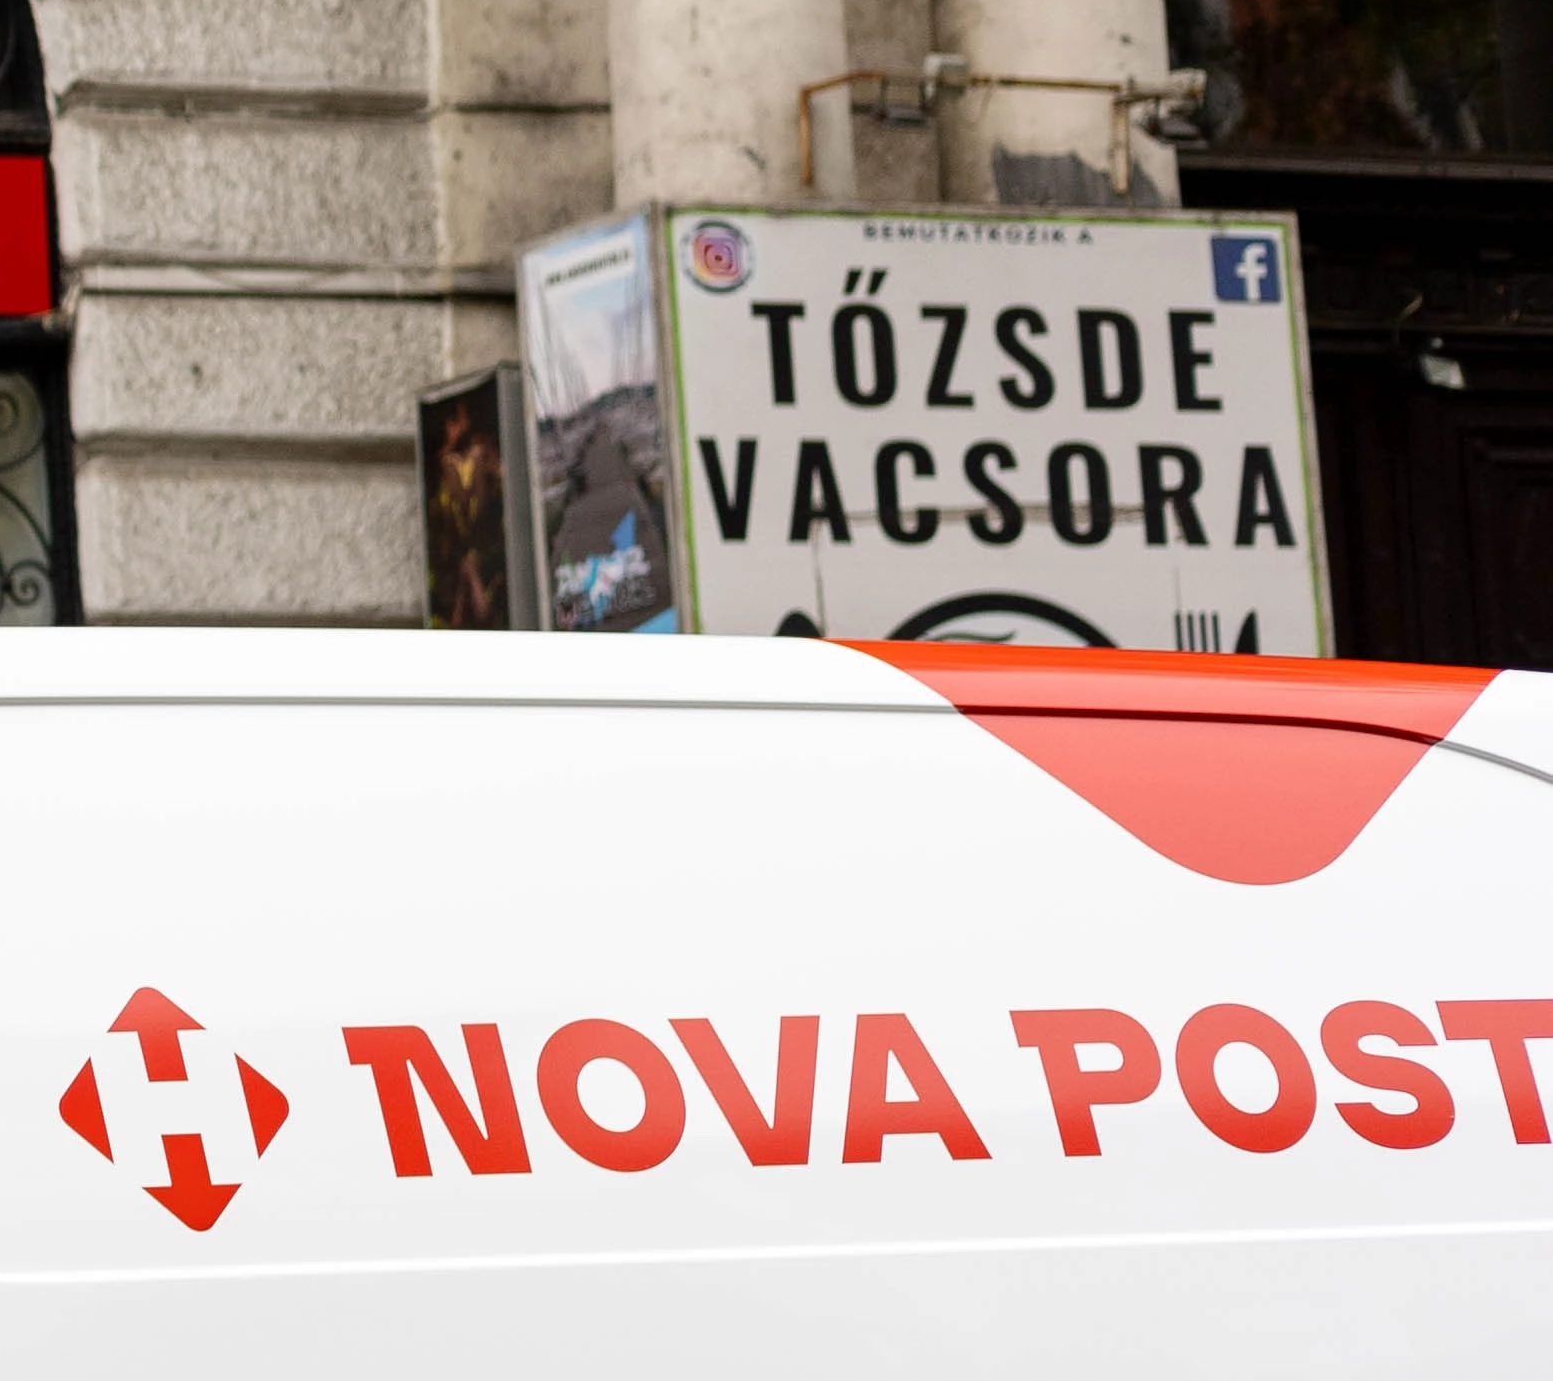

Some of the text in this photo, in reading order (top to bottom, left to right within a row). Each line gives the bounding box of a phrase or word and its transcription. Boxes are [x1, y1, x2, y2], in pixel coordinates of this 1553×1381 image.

[751, 268, 1223, 411] TŐZSDE
[698, 438, 1297, 547] VACSORA
[342, 998, 1553, 1179] NOVA POST
